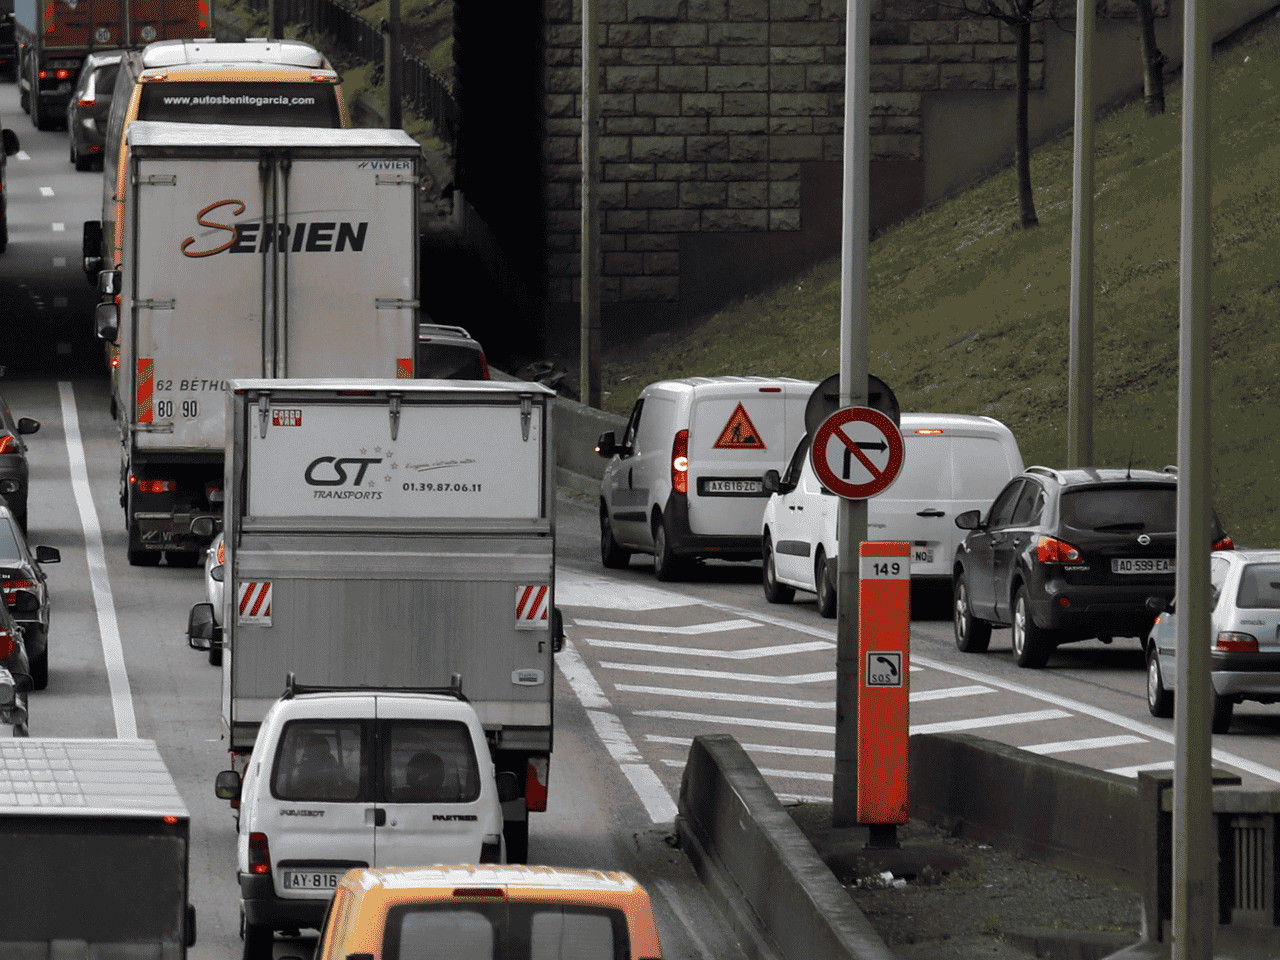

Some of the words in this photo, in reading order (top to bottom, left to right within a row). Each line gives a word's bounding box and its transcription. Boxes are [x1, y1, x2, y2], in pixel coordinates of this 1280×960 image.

[163, 95, 315, 106] www.autosbenitogarcia.com
[157, 380, 172, 391] 62
[158, 400, 173, 418] 80
[182, 400, 197, 418] 90
[304, 456, 383, 486] CST
[402, 483, 482, 492] 01.39.87.06.11
[313, 491, 383, 500] TRANSPORTS
[873, 562, 901, 576] 149
